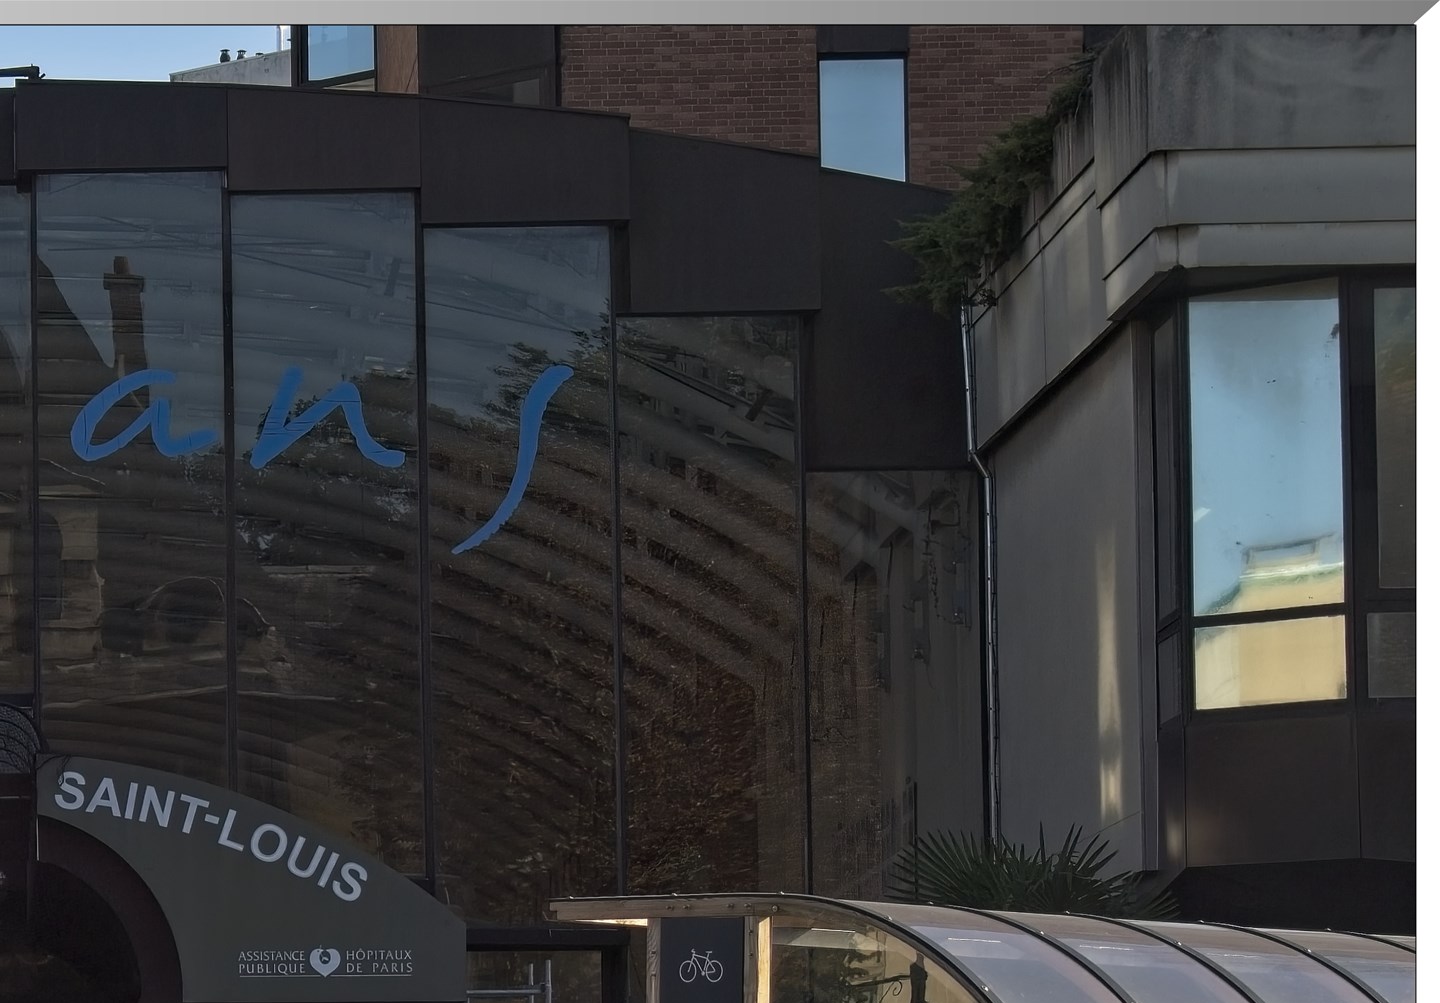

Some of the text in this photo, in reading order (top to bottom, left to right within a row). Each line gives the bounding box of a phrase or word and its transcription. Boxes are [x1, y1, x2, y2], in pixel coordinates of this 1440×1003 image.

[69, 364, 575, 555] ans
[53, 771, 369, 902] SAINT-LOUIS
[238, 950, 306, 962] ASSISTANCE
[345, 947, 413, 961] HÔPITAUX
[238, 963, 306, 976] PUBLIQUE
[346, 962, 413, 973] DE PARIS
